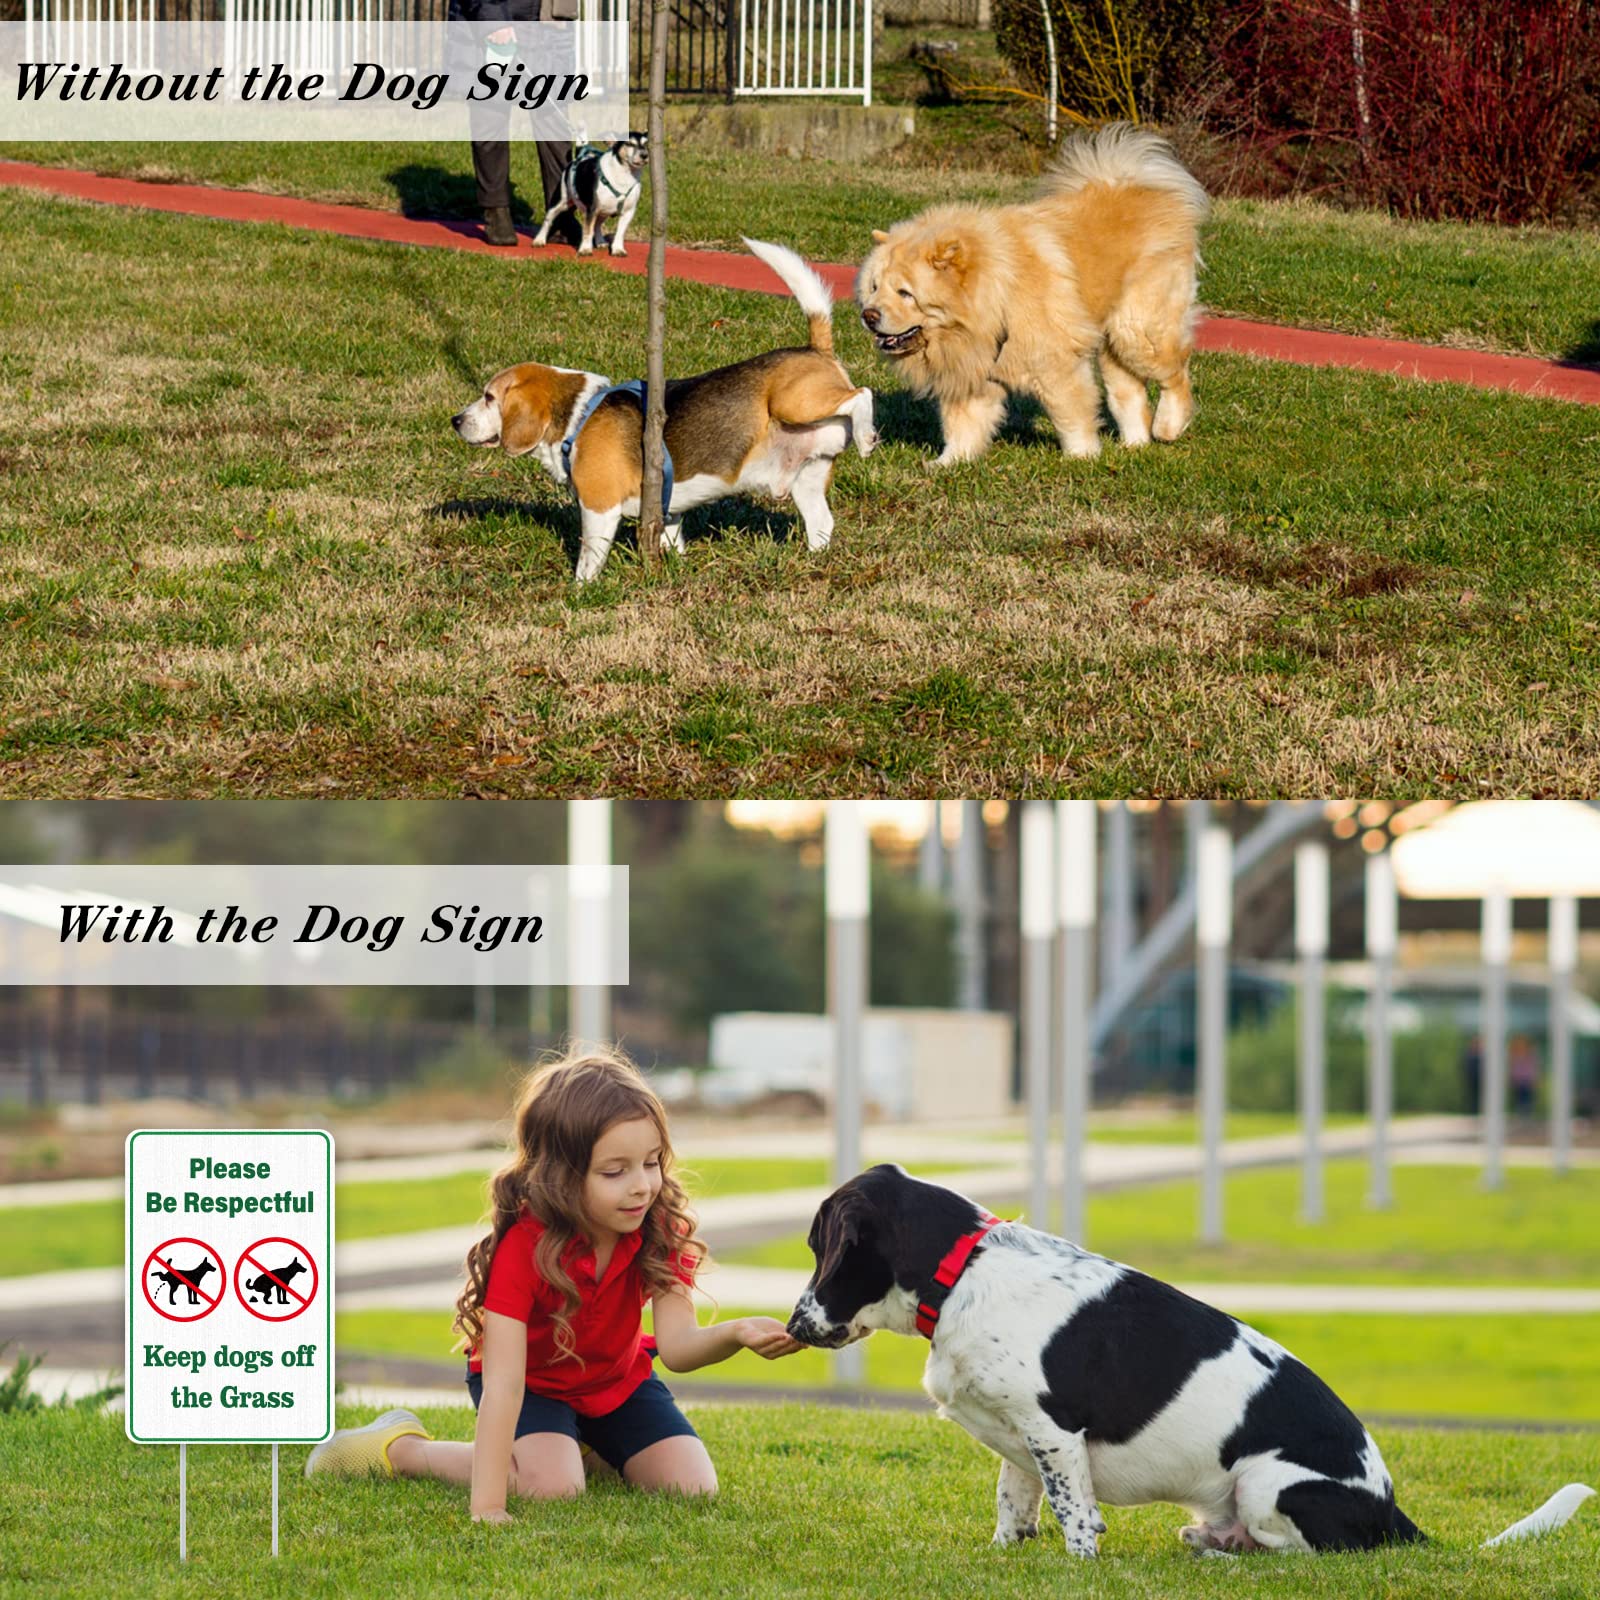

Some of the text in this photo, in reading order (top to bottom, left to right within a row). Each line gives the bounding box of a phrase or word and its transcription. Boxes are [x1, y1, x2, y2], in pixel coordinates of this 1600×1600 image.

[189, 1157, 271, 1179] Please
[146, 1191, 314, 1218] Be Respectful
[143, 1345, 317, 1373] Keep dogs off
[171, 1386, 295, 1408] the Grass
